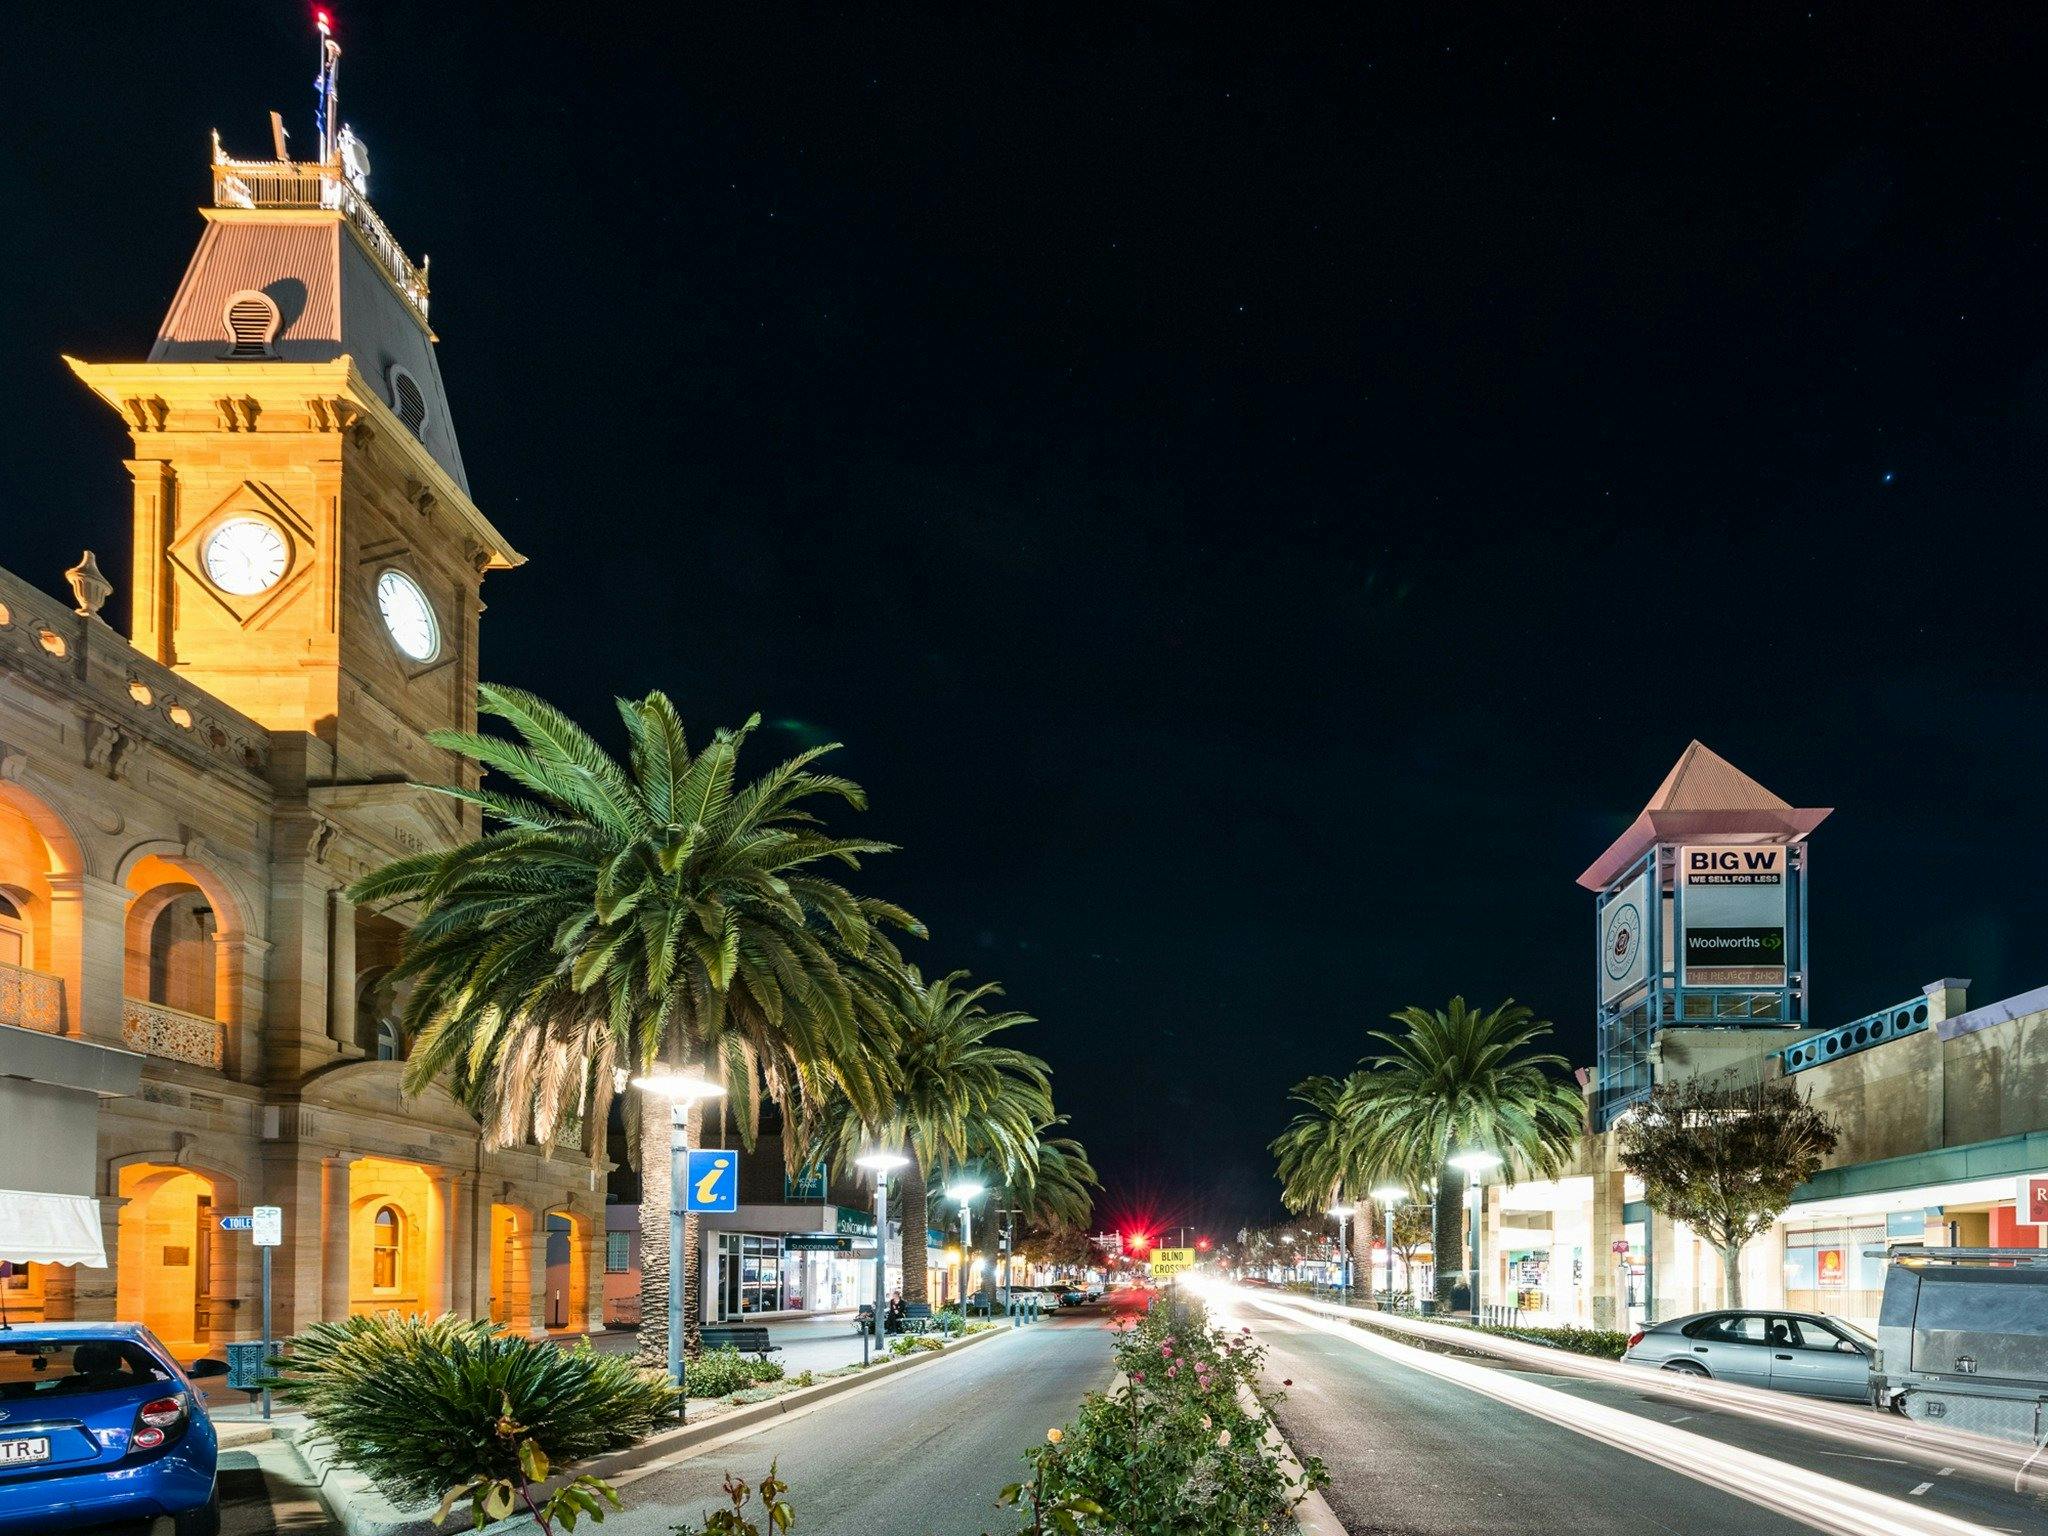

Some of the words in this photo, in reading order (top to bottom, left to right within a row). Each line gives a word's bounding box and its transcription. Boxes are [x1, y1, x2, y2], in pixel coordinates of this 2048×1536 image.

[1691, 851, 1739, 870] BIG
[1743, 851, 1777, 870] W
[1689, 937, 1760, 948] Woolworths
[1711, 971, 1752, 981] REJECT
[1754, 971, 1783, 981] SHOP
[230, 1218, 254, 1229] TOILE
[1161, 1251, 1183, 1261] BLIND
[1154, 1264, 1191, 1274] CROSSING
